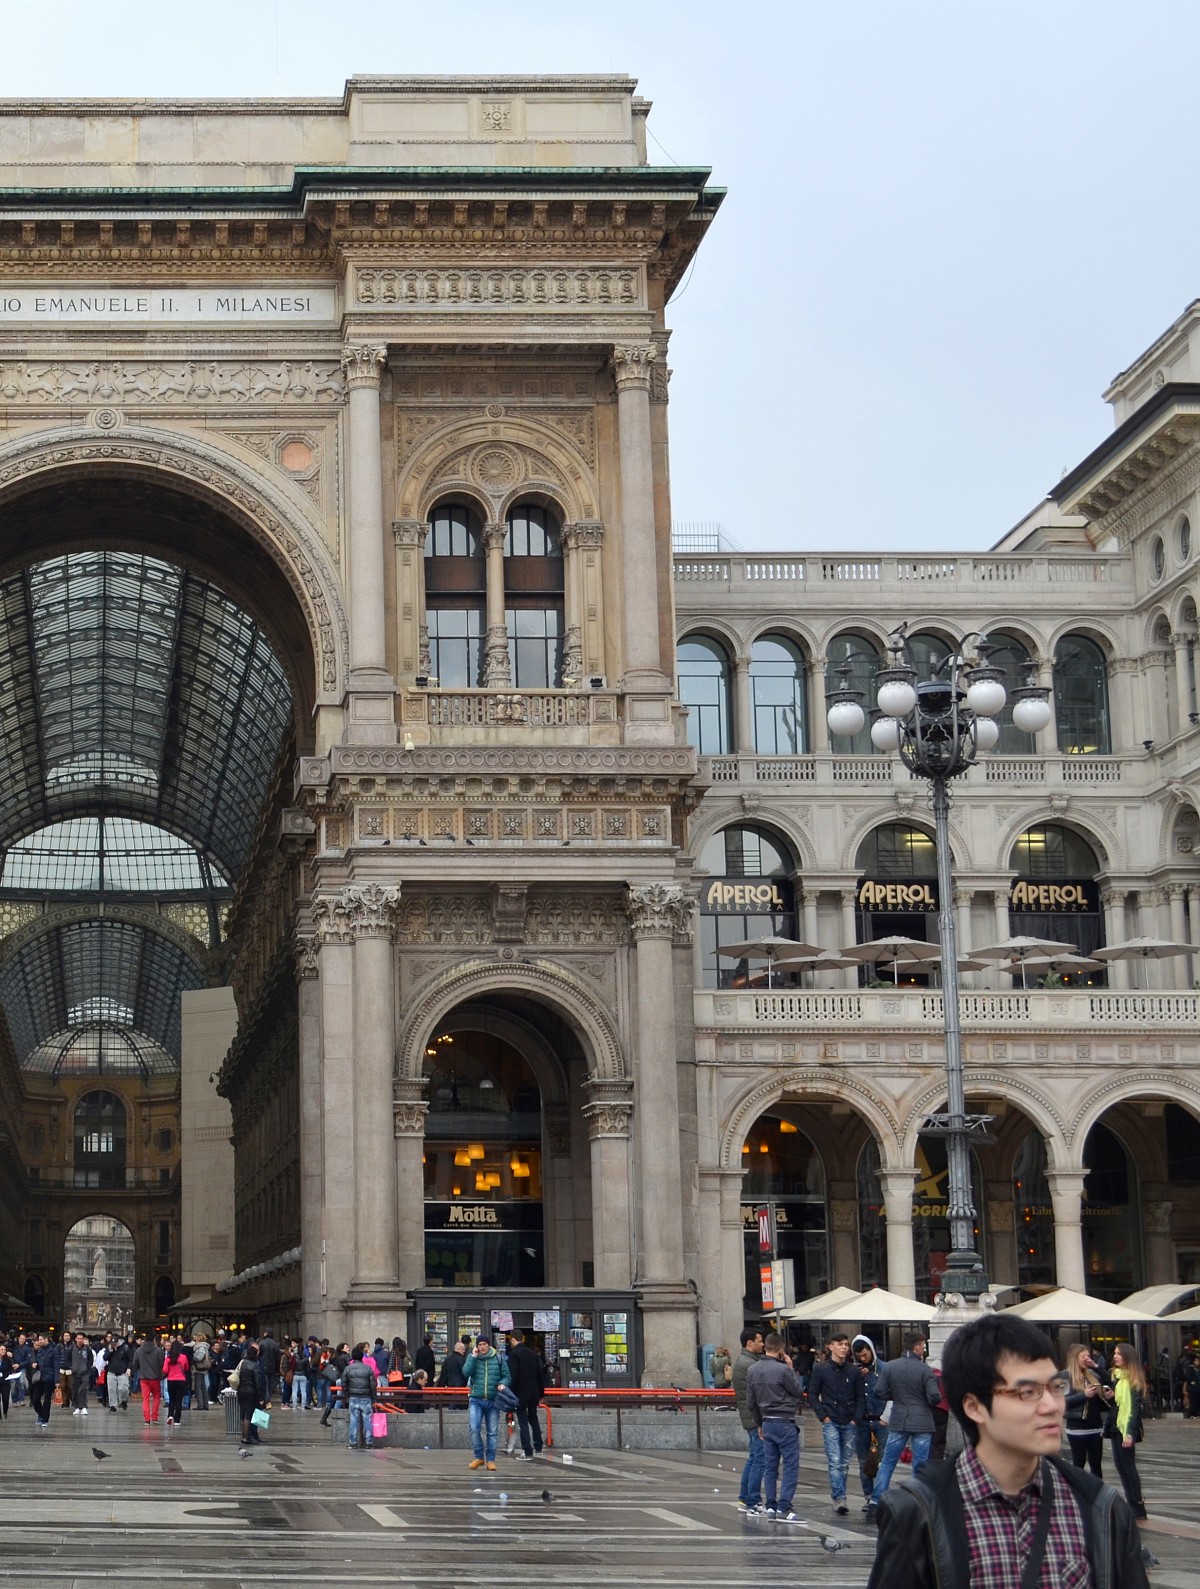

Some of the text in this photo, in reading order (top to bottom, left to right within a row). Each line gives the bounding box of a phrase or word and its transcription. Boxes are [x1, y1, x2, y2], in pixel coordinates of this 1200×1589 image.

[35, 297, 149, 312] EMANUELE
[161, 297, 179, 312] II.
[197, 298, 203, 312] I
[216, 297, 312, 312] MILANESI
[707, 881, 784, 905] APEROL
[859, 881, 935, 904] APEROL
[1012, 881, 1088, 905] APEROL
[708, 904, 784, 912] TERRAZZA
[860, 903, 936, 911] TERRAZZA
[1013, 904, 1089, 912] TERRAZZA
[449, 1206, 498, 1223] Motta
[759, 1215, 770, 1243] M
